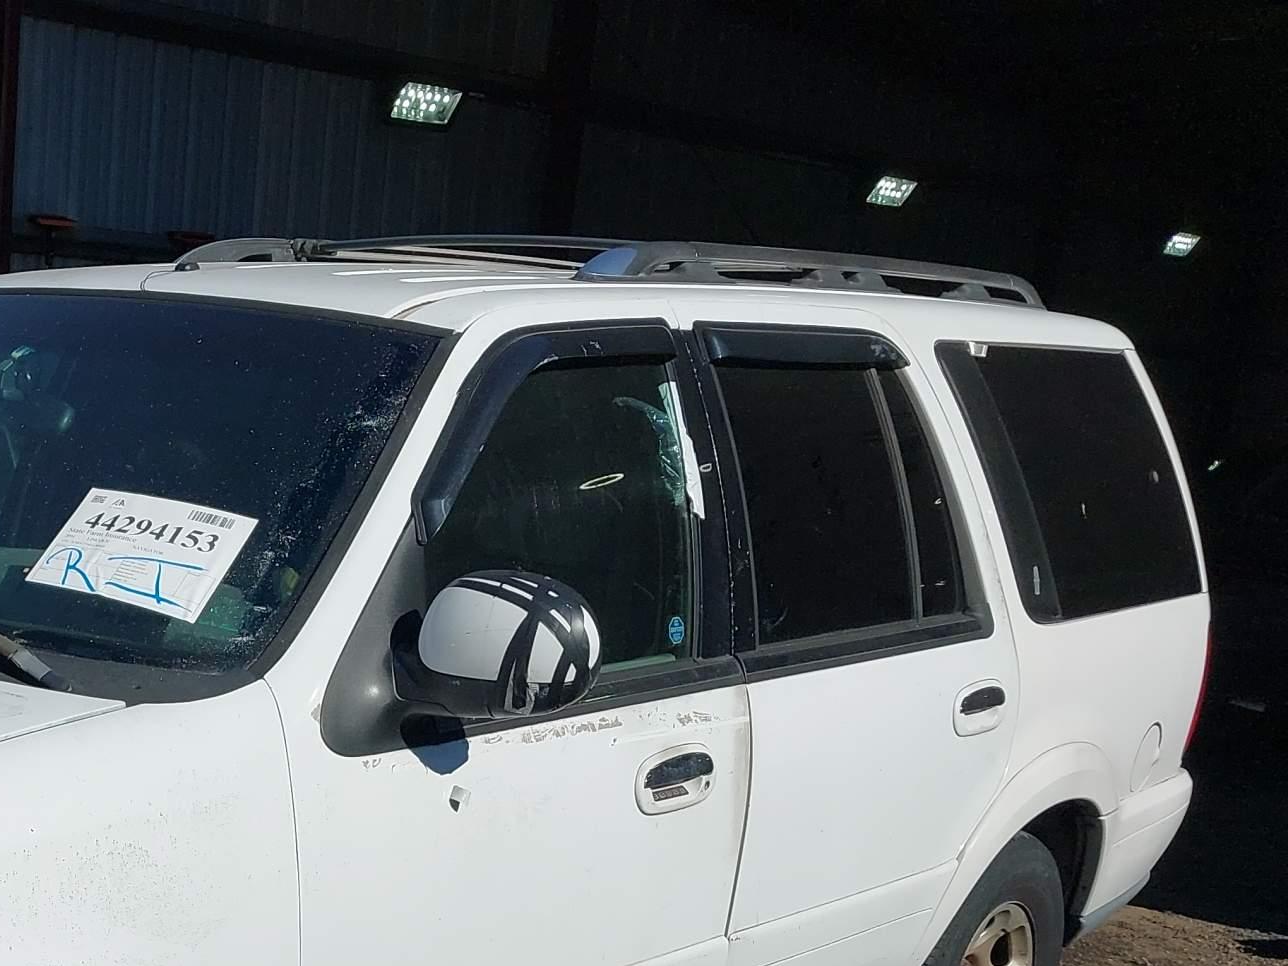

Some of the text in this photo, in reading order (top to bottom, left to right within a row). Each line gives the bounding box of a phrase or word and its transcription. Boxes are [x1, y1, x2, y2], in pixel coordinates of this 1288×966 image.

[84, 512, 219, 552] 44294153
[86, 529, 104, 537] Farm
[105, 531, 137, 543] Insurance
